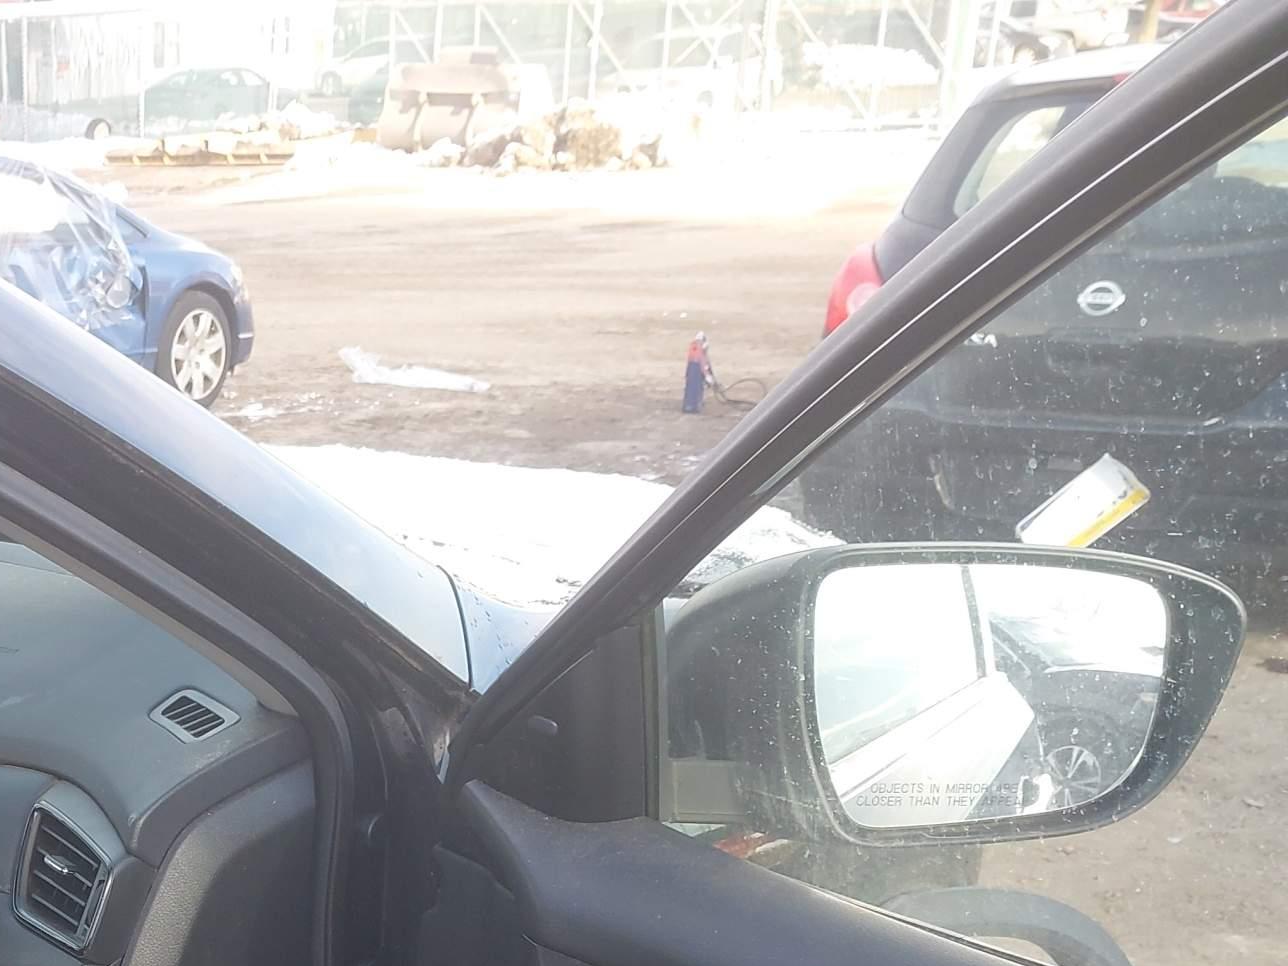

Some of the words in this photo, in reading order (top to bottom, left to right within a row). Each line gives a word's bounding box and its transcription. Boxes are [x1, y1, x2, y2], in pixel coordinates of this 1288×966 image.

[870, 783, 924, 794] OBJECTS
[929, 783, 940, 794] IN
[945, 783, 988, 794] MIRROR
[856, 795, 902, 807] CLOSER
[910, 795, 940, 807] THAN
[947, 795, 975, 807] THEY
